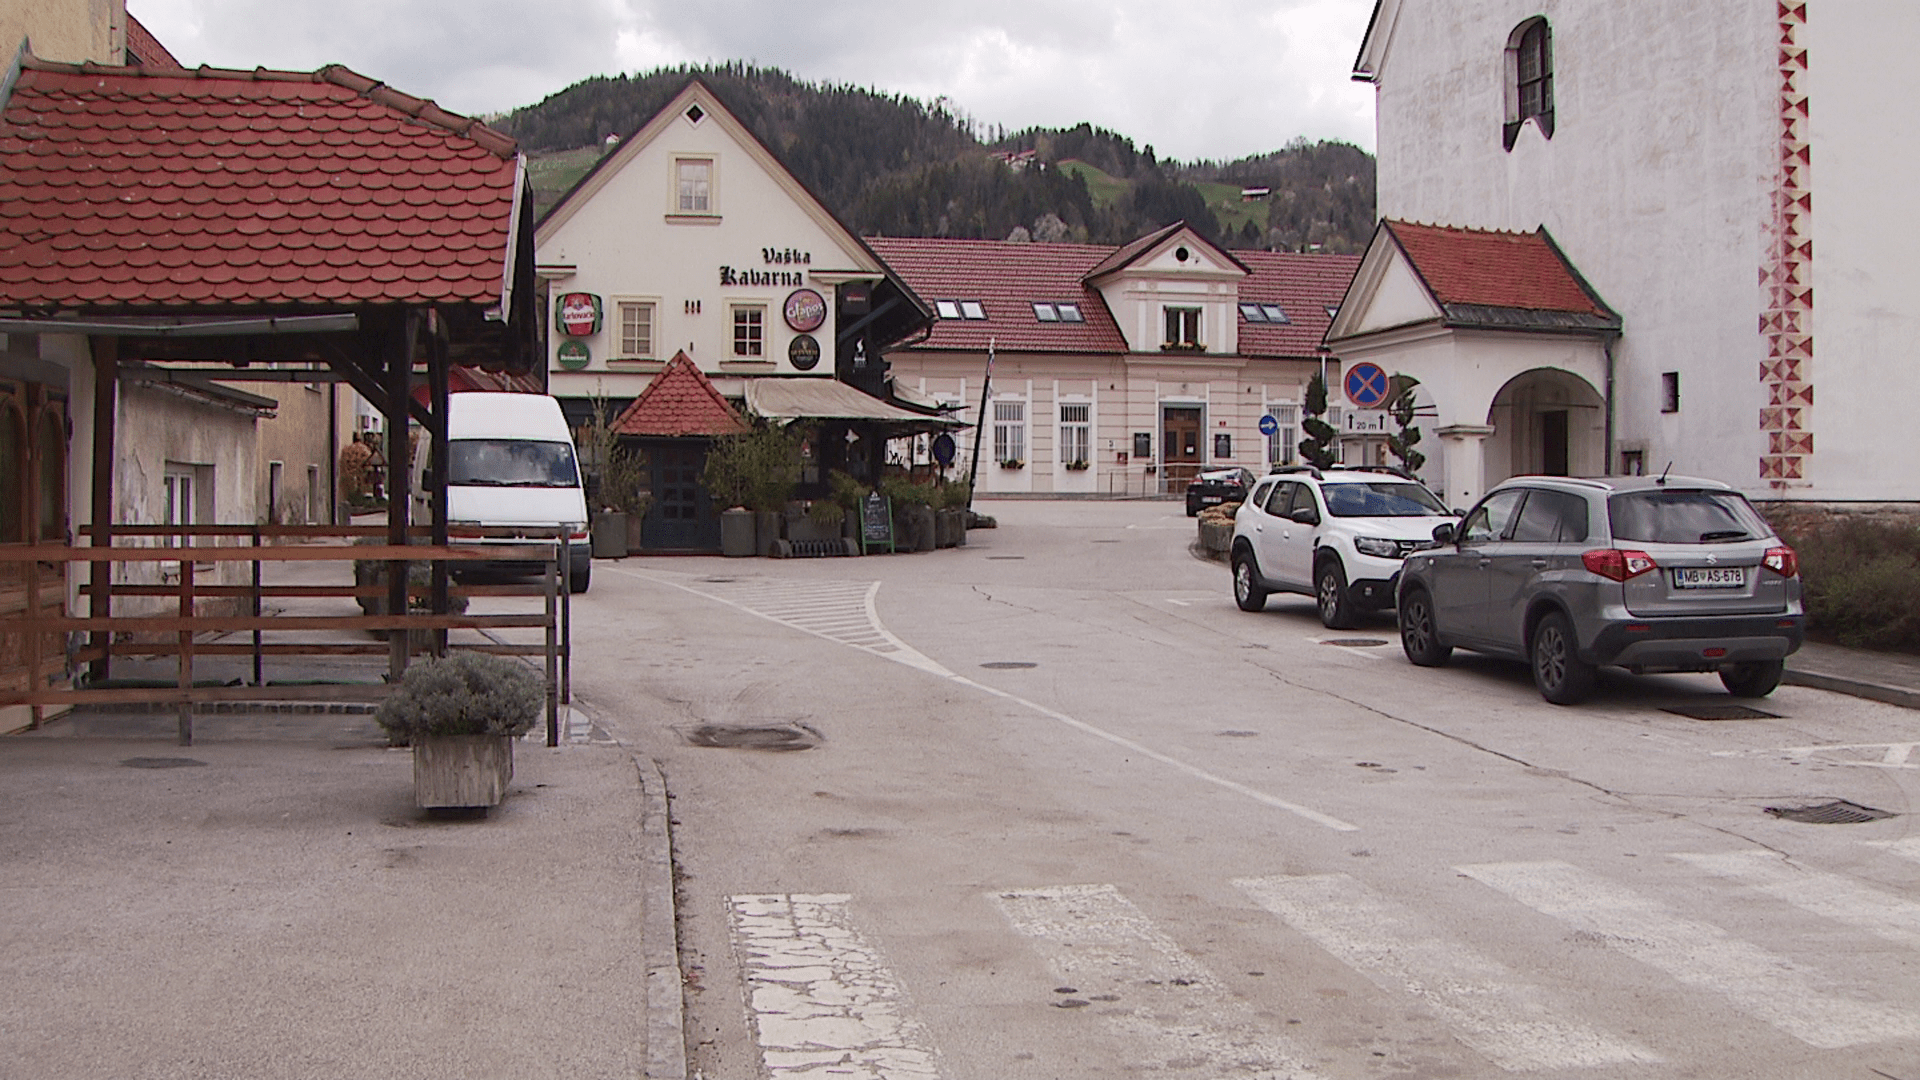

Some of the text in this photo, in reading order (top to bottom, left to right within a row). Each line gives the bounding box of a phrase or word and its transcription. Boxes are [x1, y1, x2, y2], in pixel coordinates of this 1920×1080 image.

[762, 248, 811, 265] Vaška
[719, 266, 803, 286] Kavarna
[1356, 422, 1367, 430] 20
[1684, 569, 1700, 582] MB
